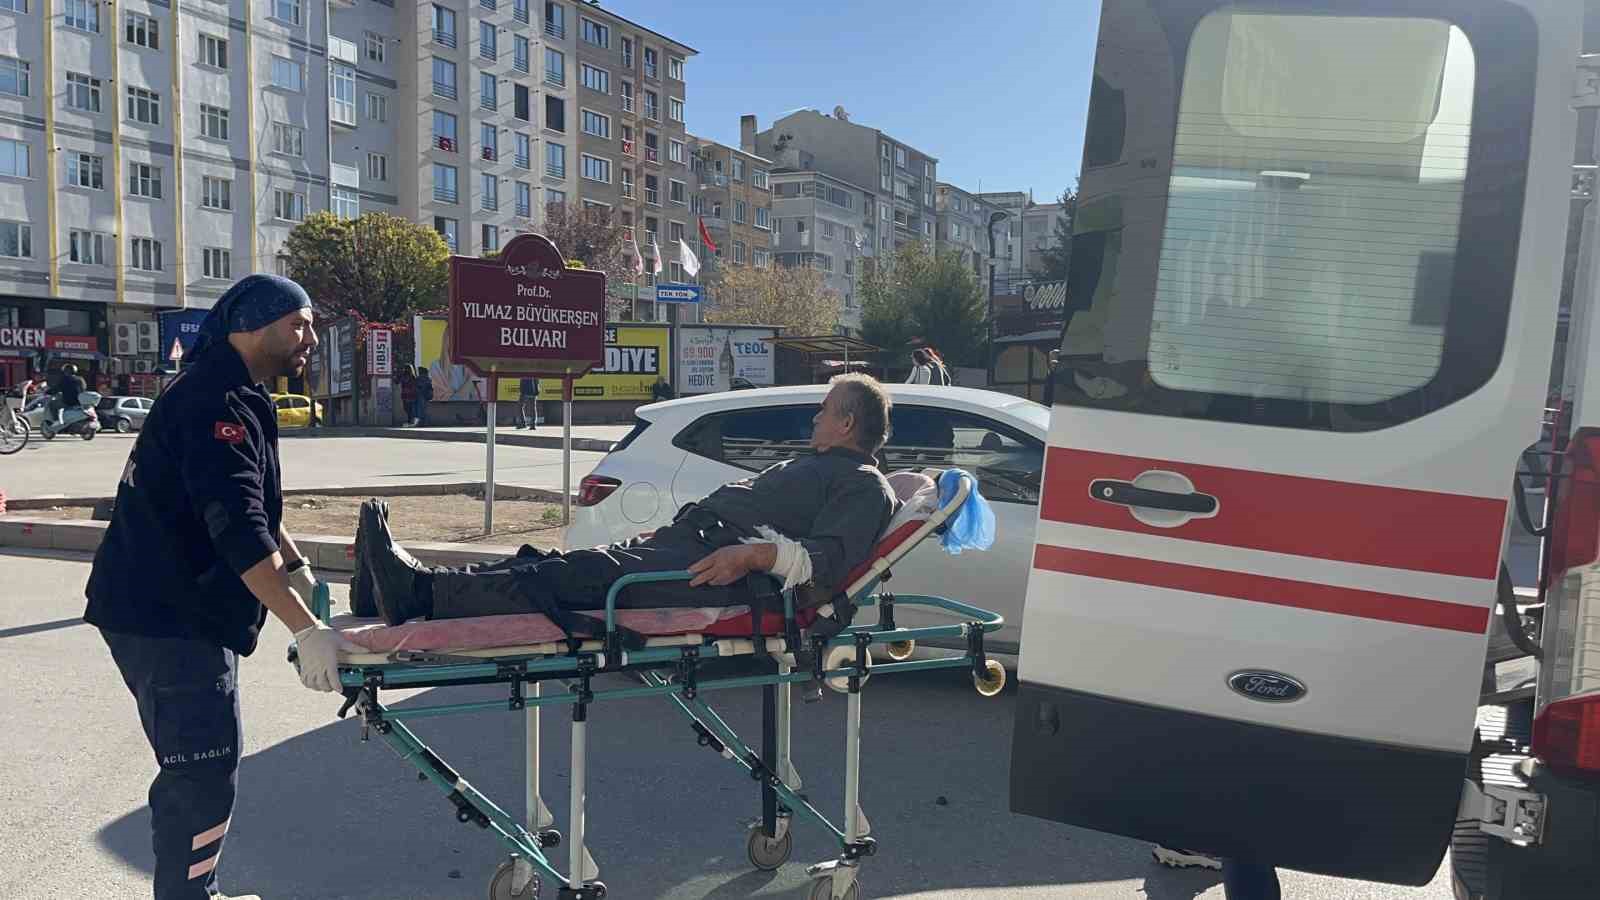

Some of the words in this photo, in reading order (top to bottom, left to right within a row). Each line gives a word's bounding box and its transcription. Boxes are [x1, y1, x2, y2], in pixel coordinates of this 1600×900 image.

[517, 284, 552, 299] Prof.Dr.
[463, 302, 513, 320] YILMAZ
[517, 303, 599, 328] BÜYÜKERŞEN
[500, 327, 567, 349] BULVARI
[592, 347, 657, 372] DİYE
[1244, 676, 1290, 696] Ford
